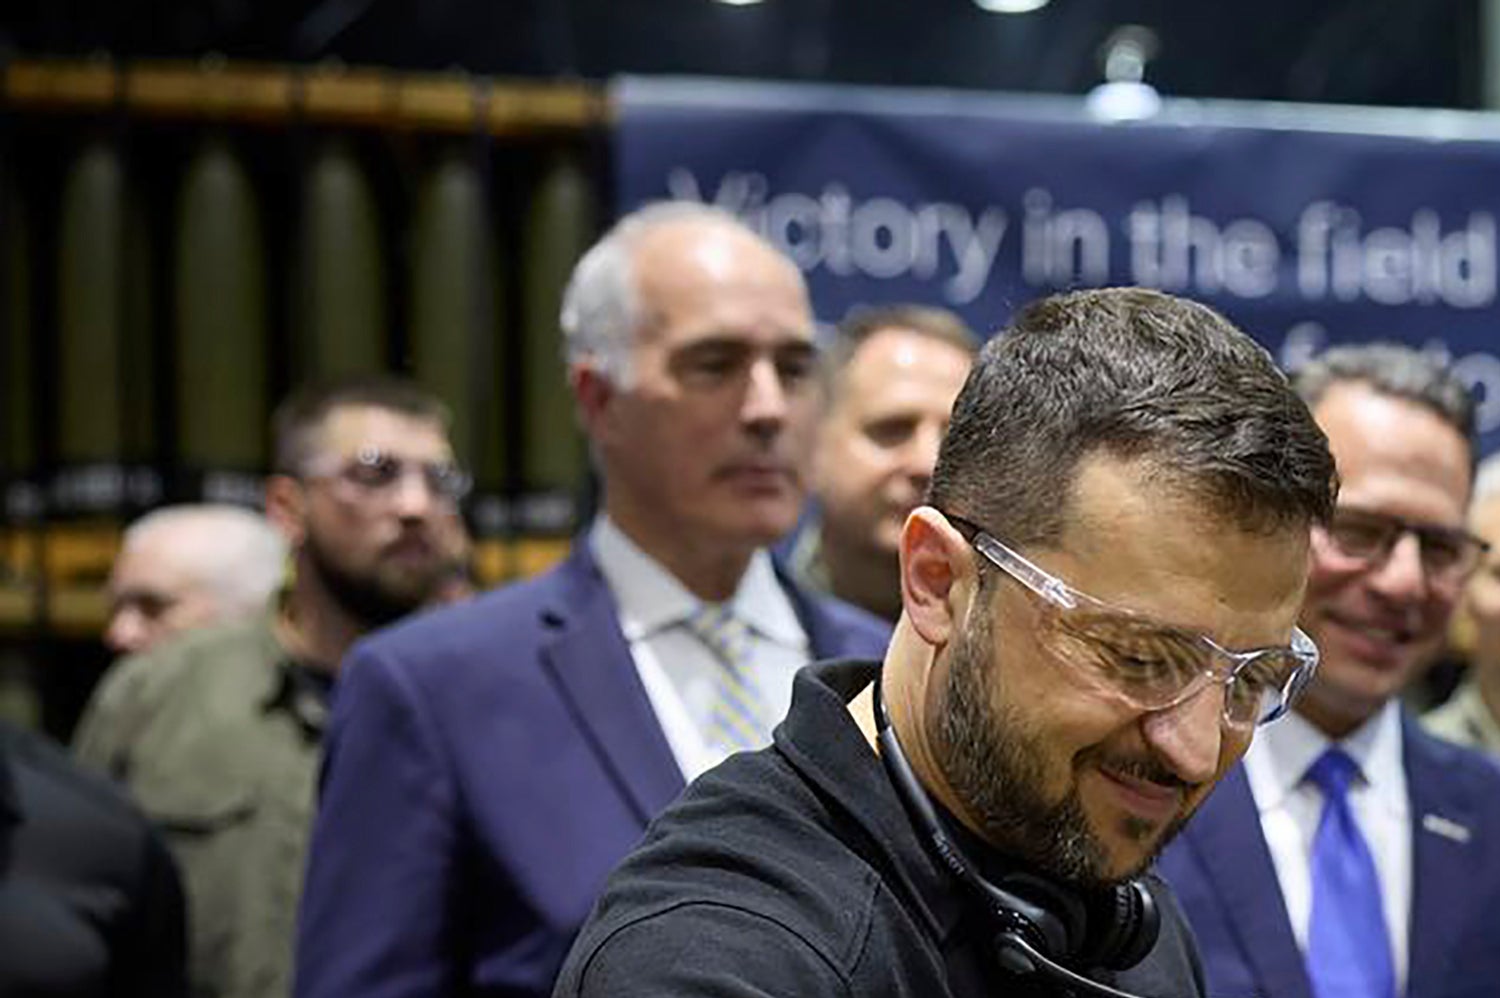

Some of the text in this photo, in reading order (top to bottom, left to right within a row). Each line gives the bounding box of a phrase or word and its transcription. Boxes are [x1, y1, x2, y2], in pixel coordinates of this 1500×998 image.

[1021, 187, 1110, 288] in
[1127, 193, 1282, 298] the
[1298, 199, 1497, 308] field
